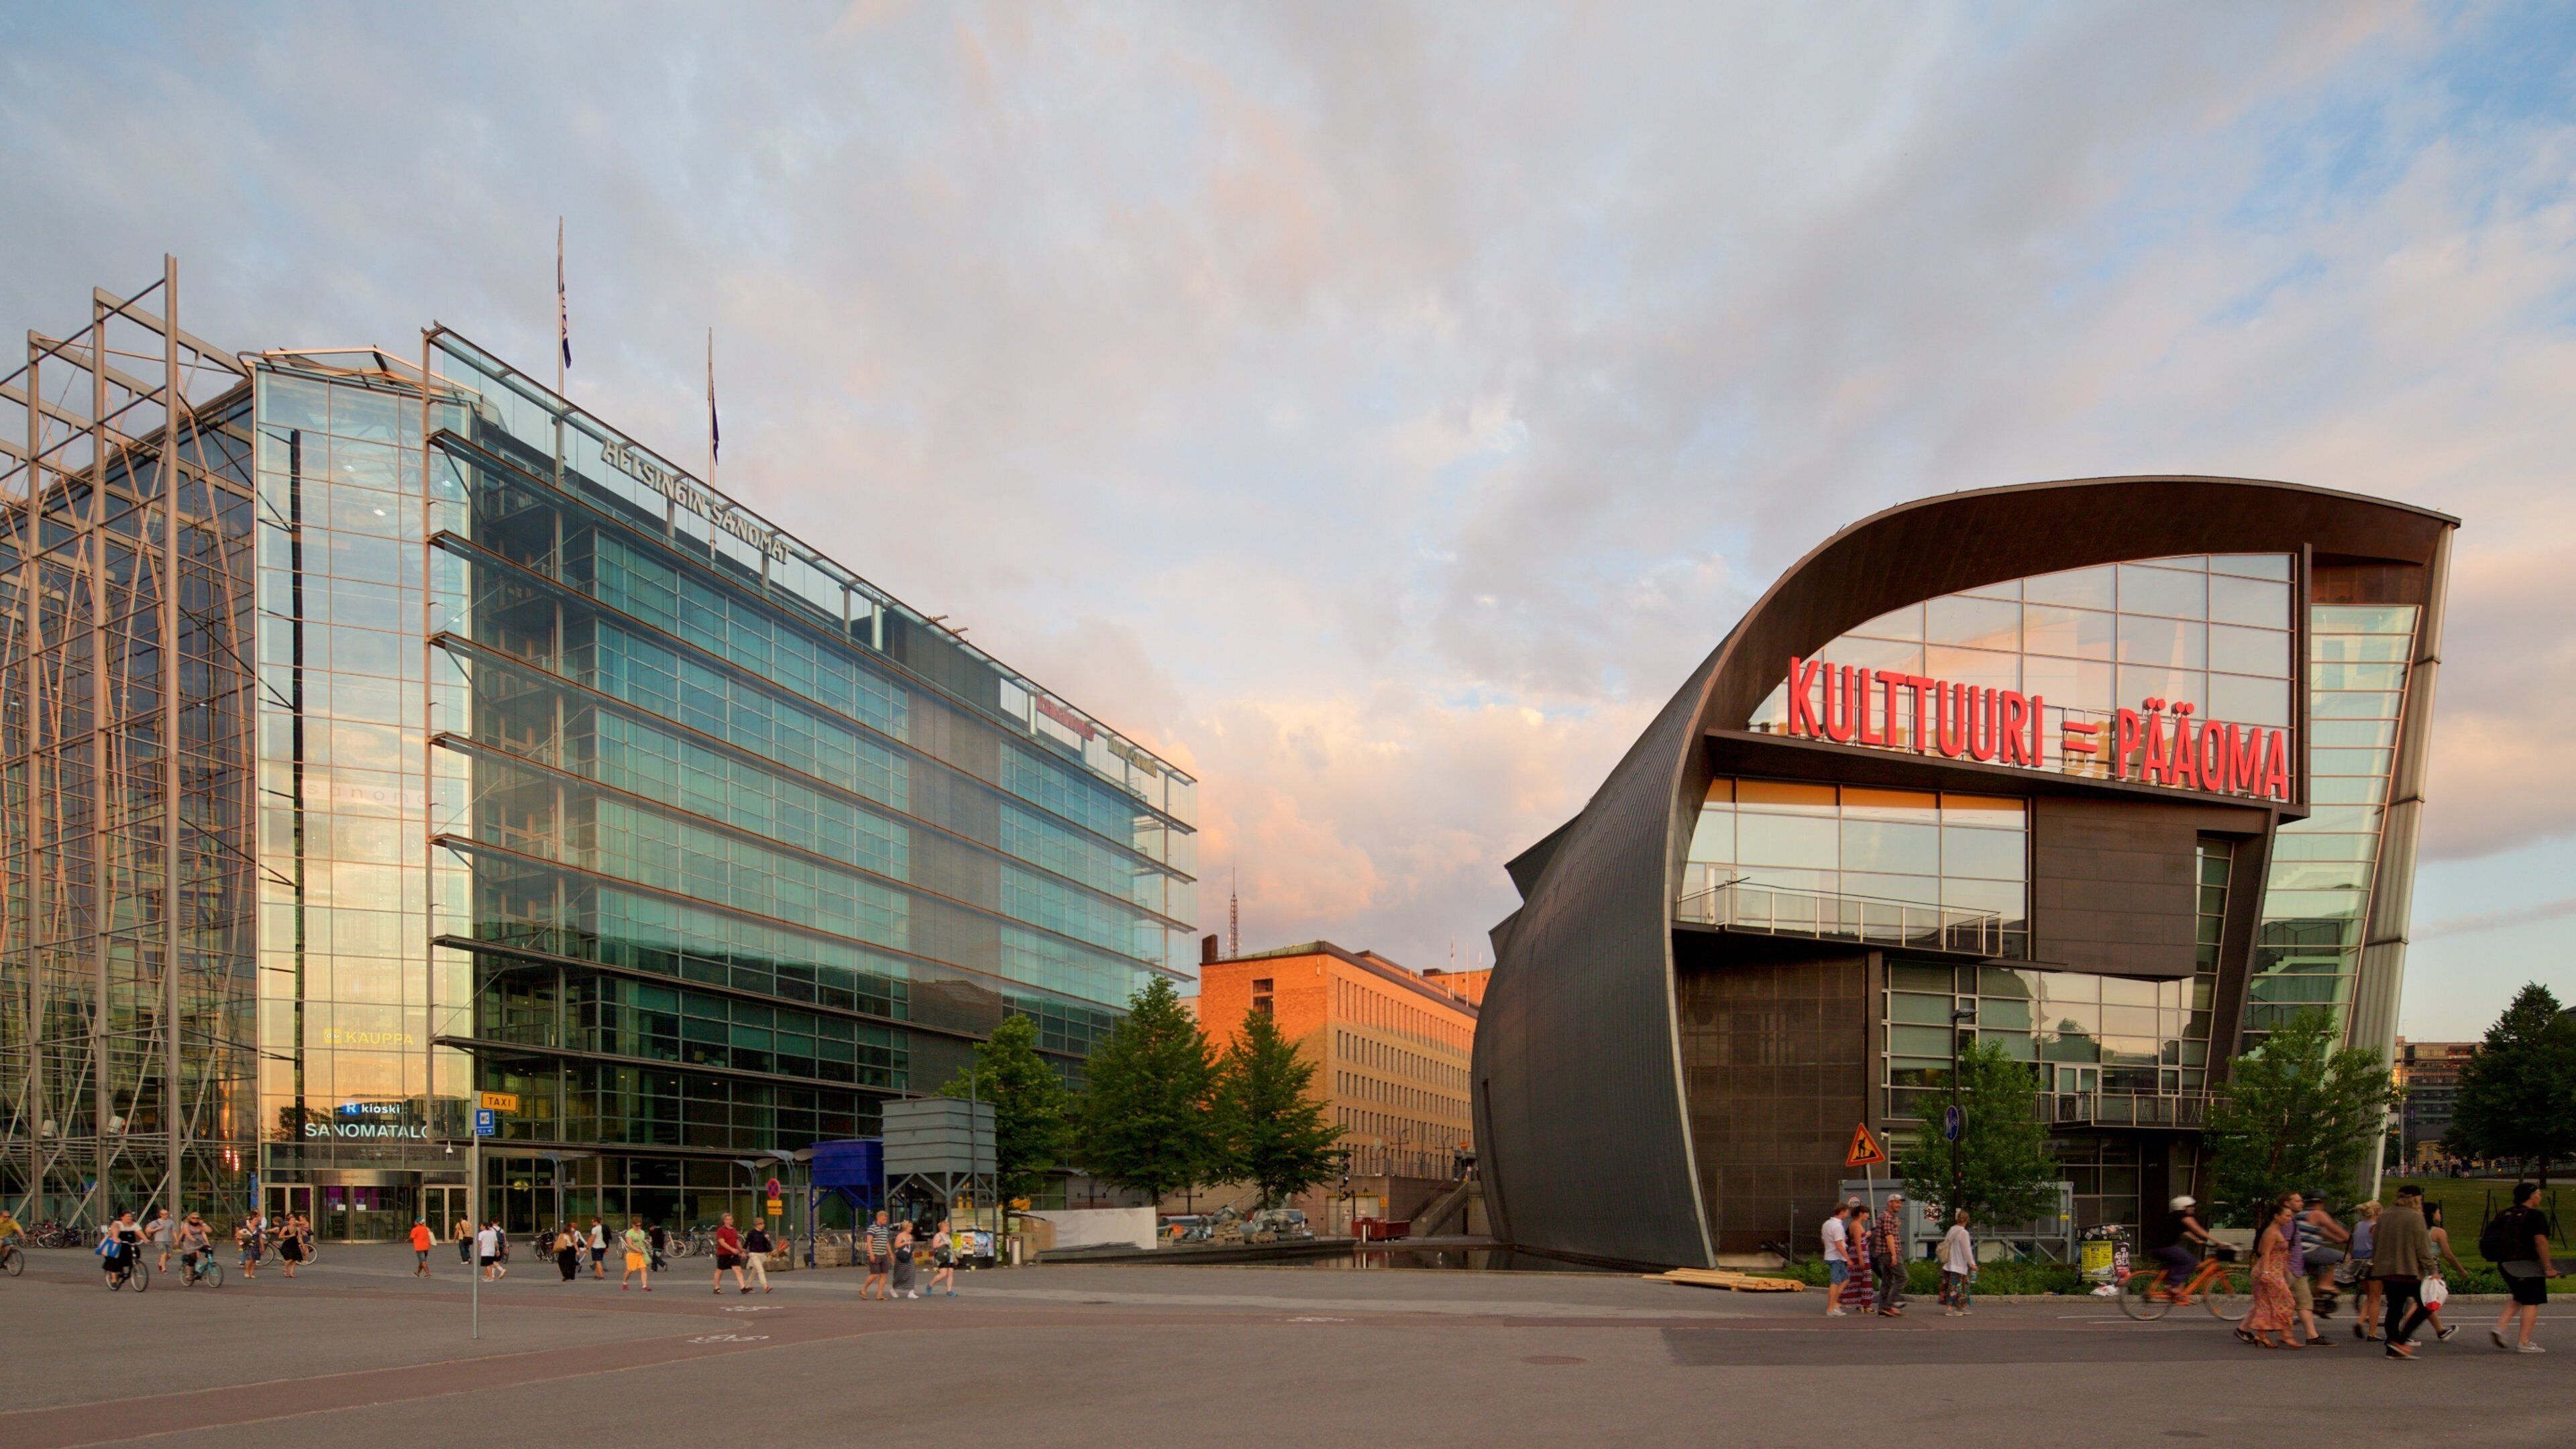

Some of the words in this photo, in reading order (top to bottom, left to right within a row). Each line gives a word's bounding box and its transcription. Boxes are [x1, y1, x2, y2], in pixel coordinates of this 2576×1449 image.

[601, 440, 704, 517] HELSINGIN
[710, 503, 792, 565] SANOMAT
[1788, 656, 2043, 767] KULTTUURI
[2061, 720, 2098, 753] =
[2115, 696, 2289, 799] PÄÄOMA
[345, 1031, 414, 1046] KAUPPA
[345, 1102, 357, 1113] R
[362, 1104, 400, 1114] kioski
[488, 1097, 511, 1107] TAXI
